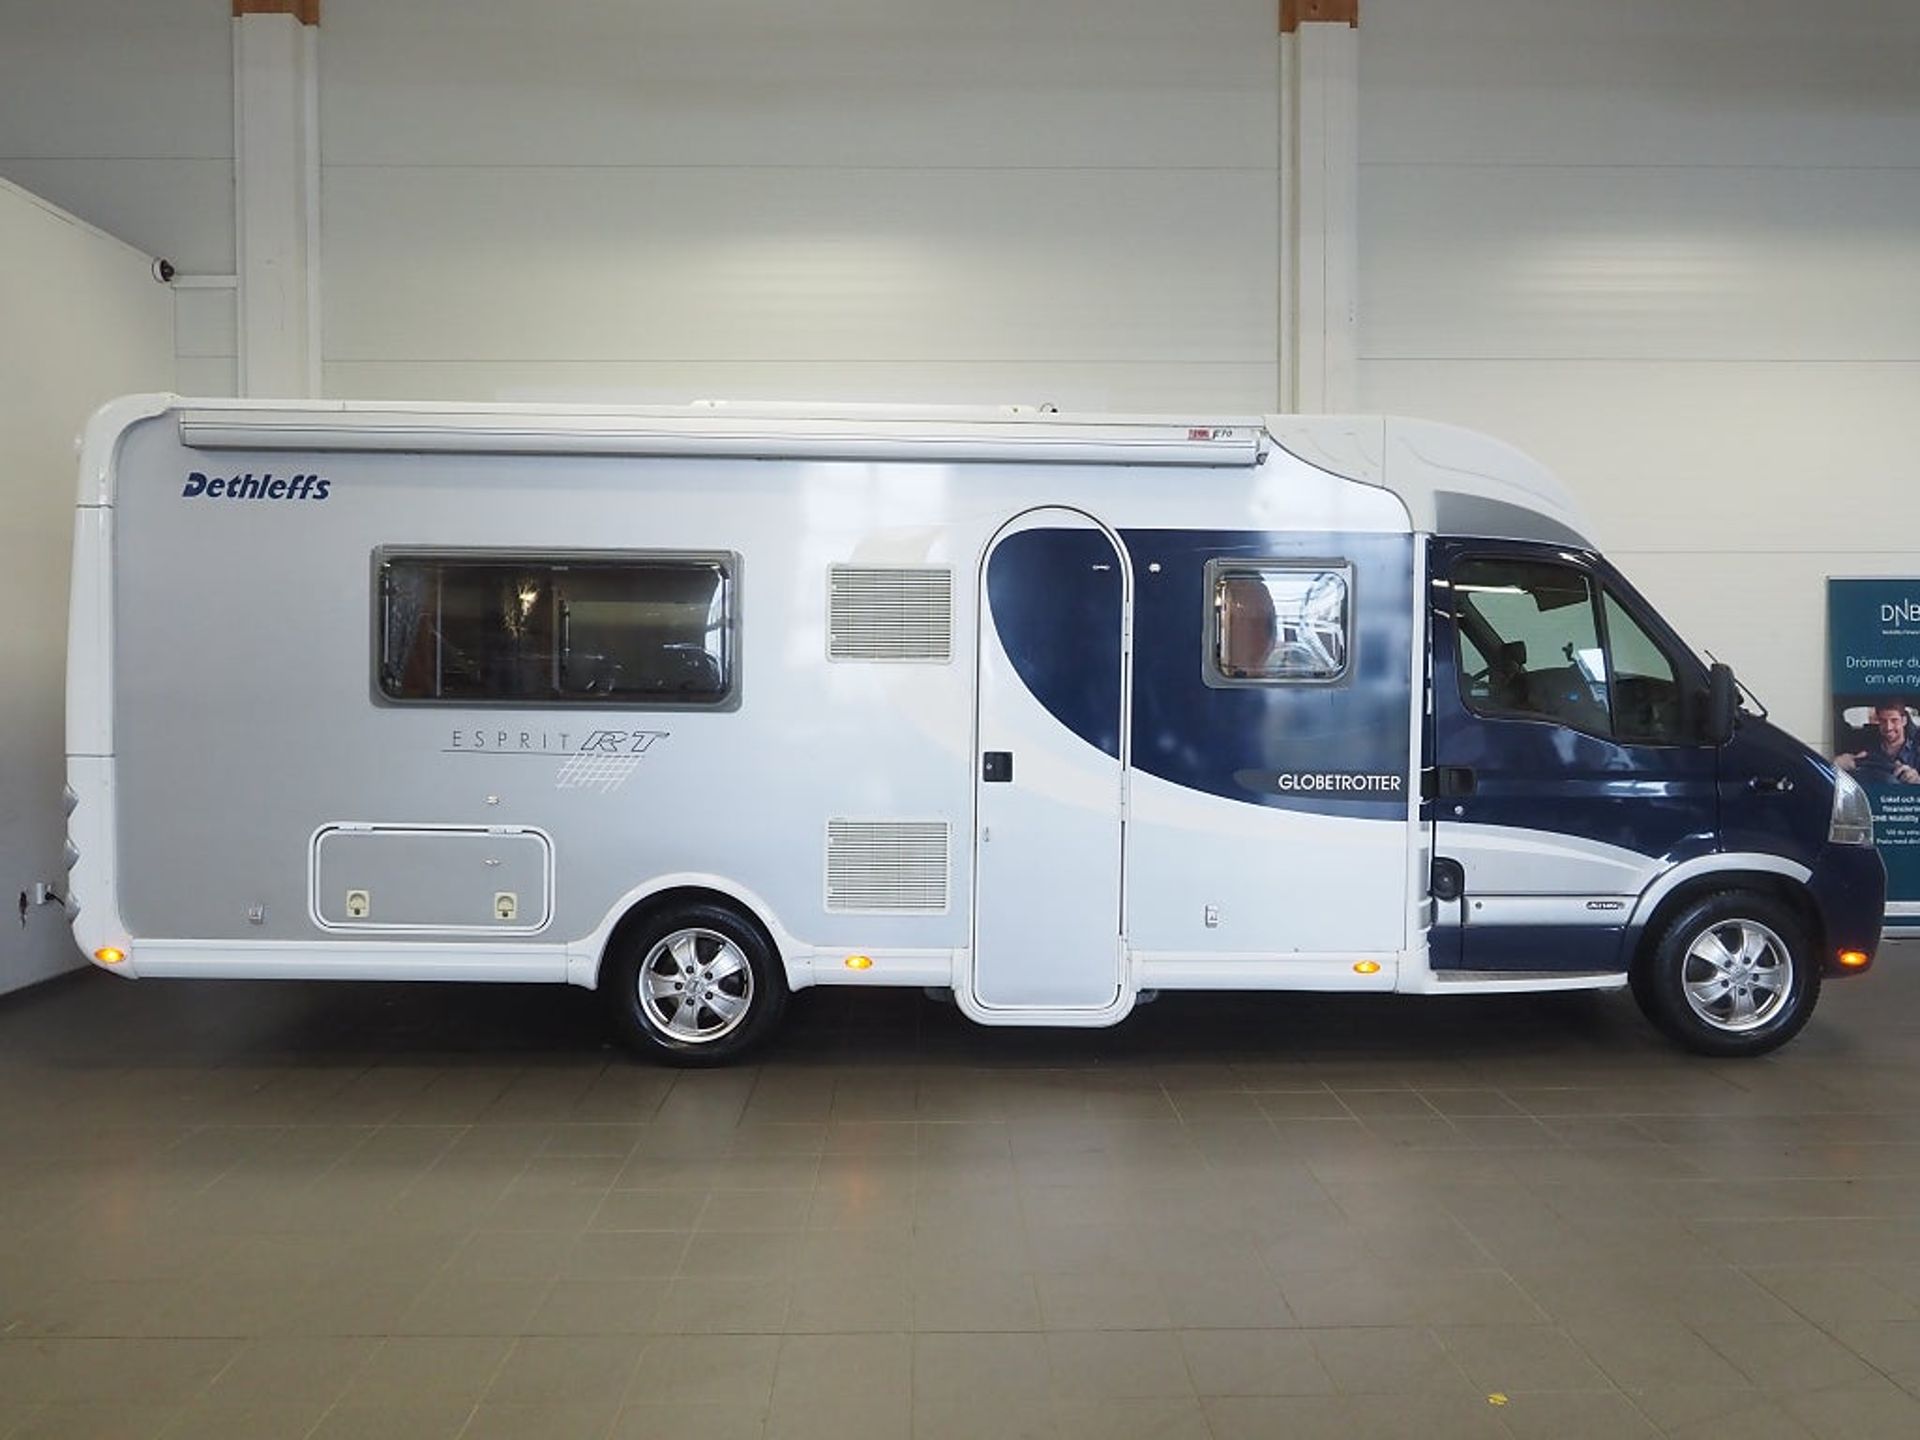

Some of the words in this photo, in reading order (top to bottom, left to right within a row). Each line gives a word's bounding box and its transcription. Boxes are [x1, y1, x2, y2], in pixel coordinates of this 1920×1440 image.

[181, 471, 331, 500] Dethleffs
[1881, 598, 1920, 628] DNB
[1846, 655, 1904, 669] Drömmer
[1865, 674, 1886, 685] om
[1887, 674, 1904, 685] en
[452, 730, 571, 751] ESPRIT
[581, 730, 671, 753] RT
[1278, 773, 1401, 791] GLOBETROTTER
